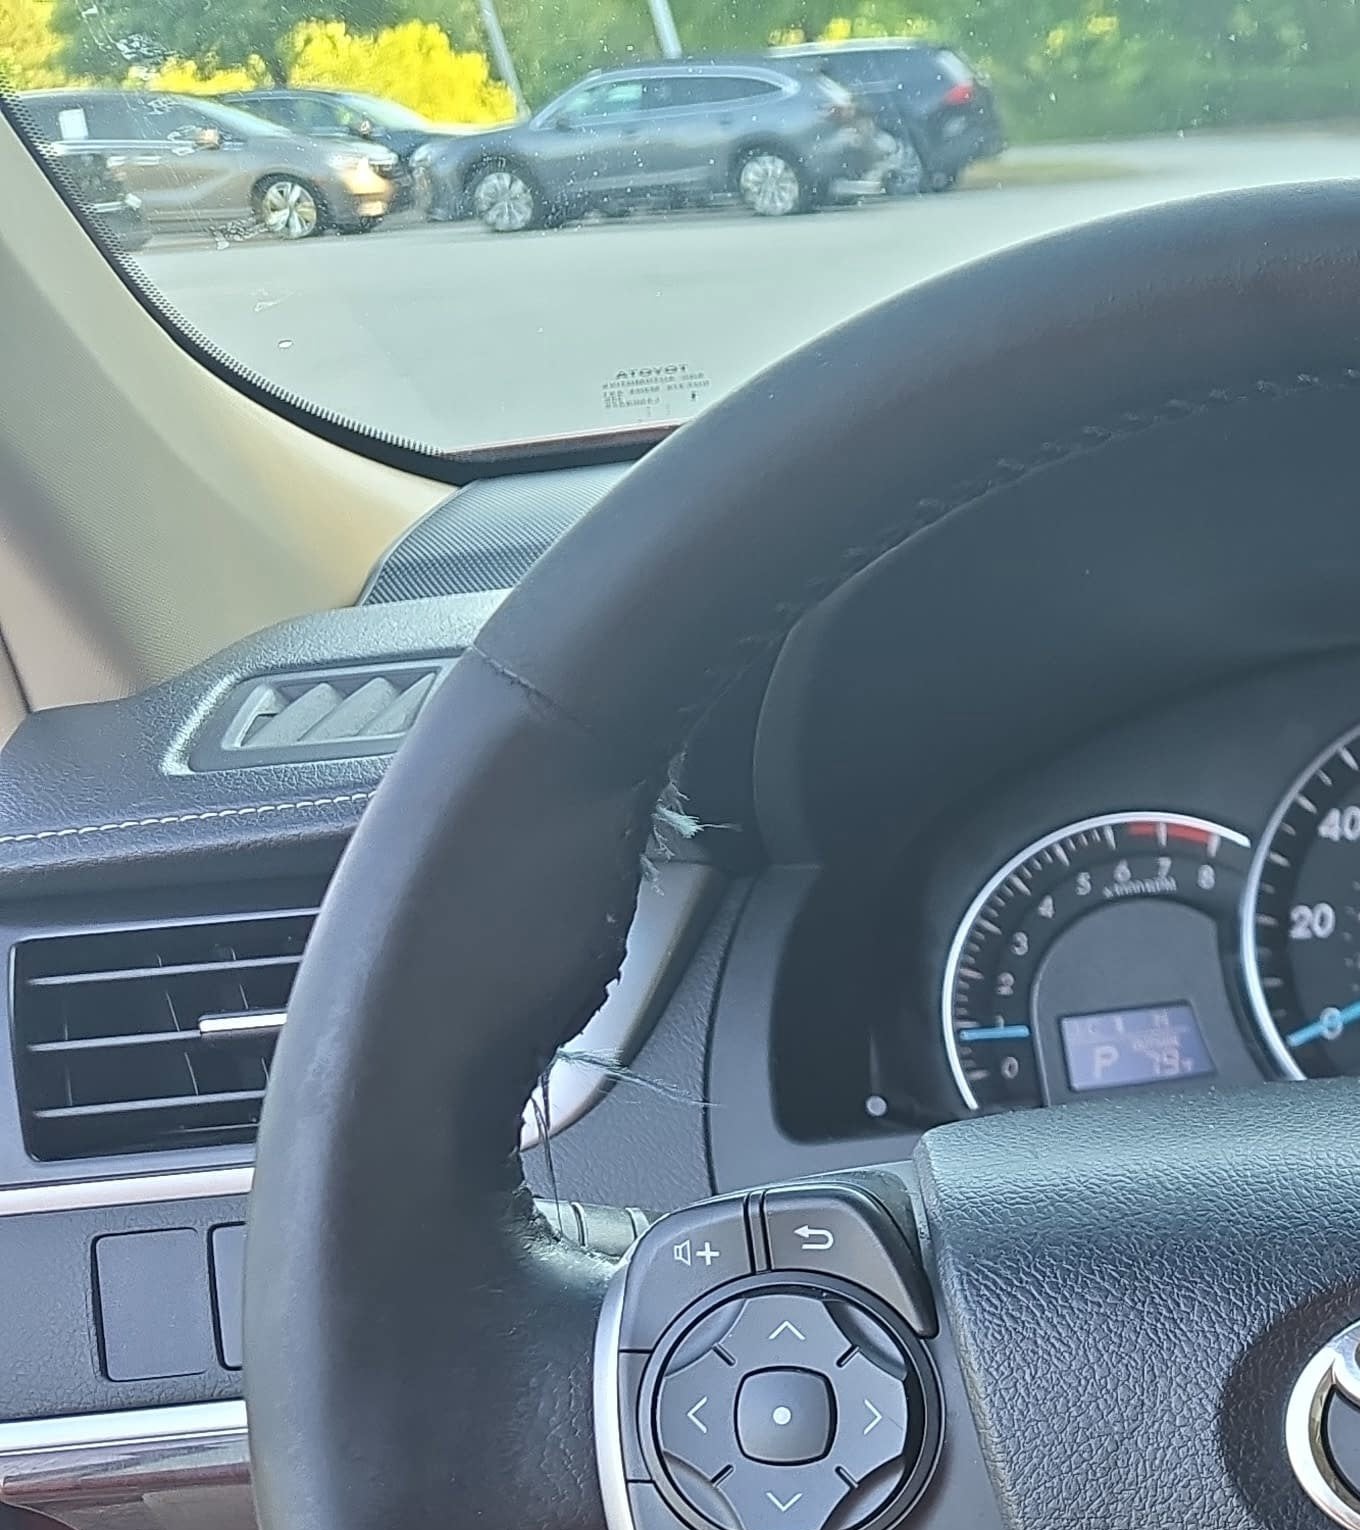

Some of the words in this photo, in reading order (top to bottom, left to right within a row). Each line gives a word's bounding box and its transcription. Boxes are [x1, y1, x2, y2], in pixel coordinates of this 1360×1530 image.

[1075, 871, 1092, 896] 5
[1198, 864, 1216, 890] 8
[1038, 894, 1056, 919] 4
[1288, 903, 1336, 939] 20
[1011, 931, 1030, 956] 3
[1002, 1056, 1019, 1080] 0
